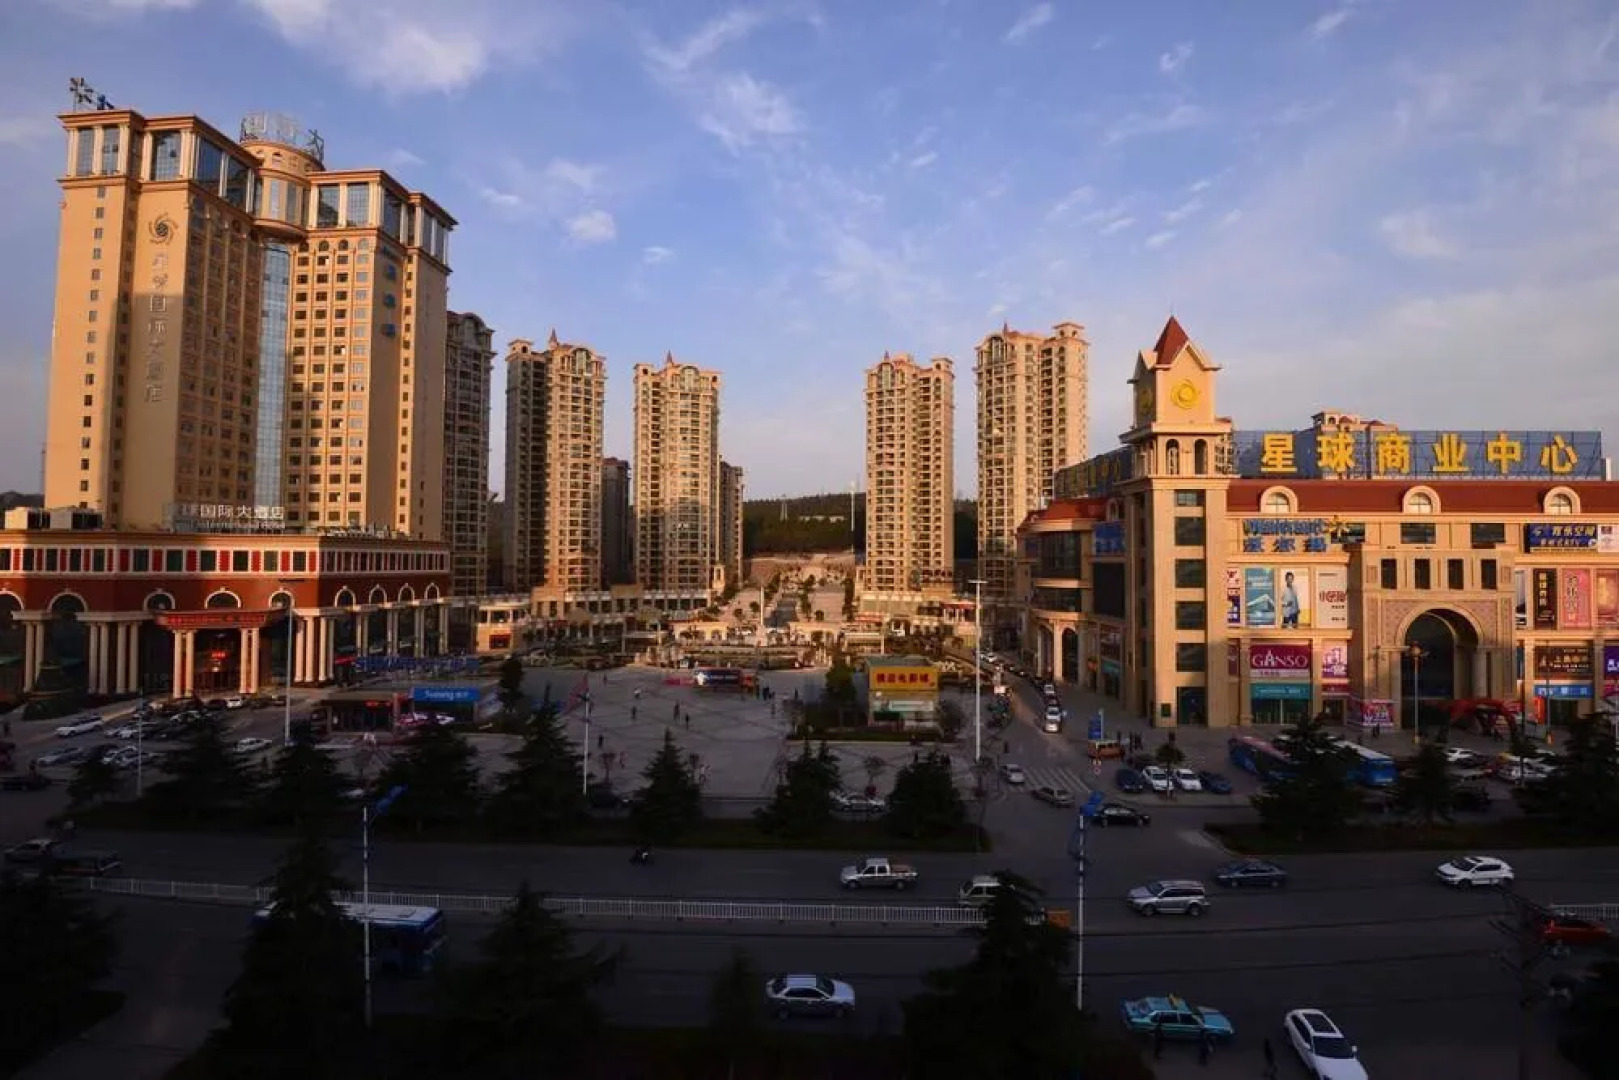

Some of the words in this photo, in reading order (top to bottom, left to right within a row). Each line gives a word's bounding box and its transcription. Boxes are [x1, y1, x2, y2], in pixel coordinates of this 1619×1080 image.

[1260, 433, 1578, 474] 星球商业中心
[1252, 649, 1307, 668] GANSO
